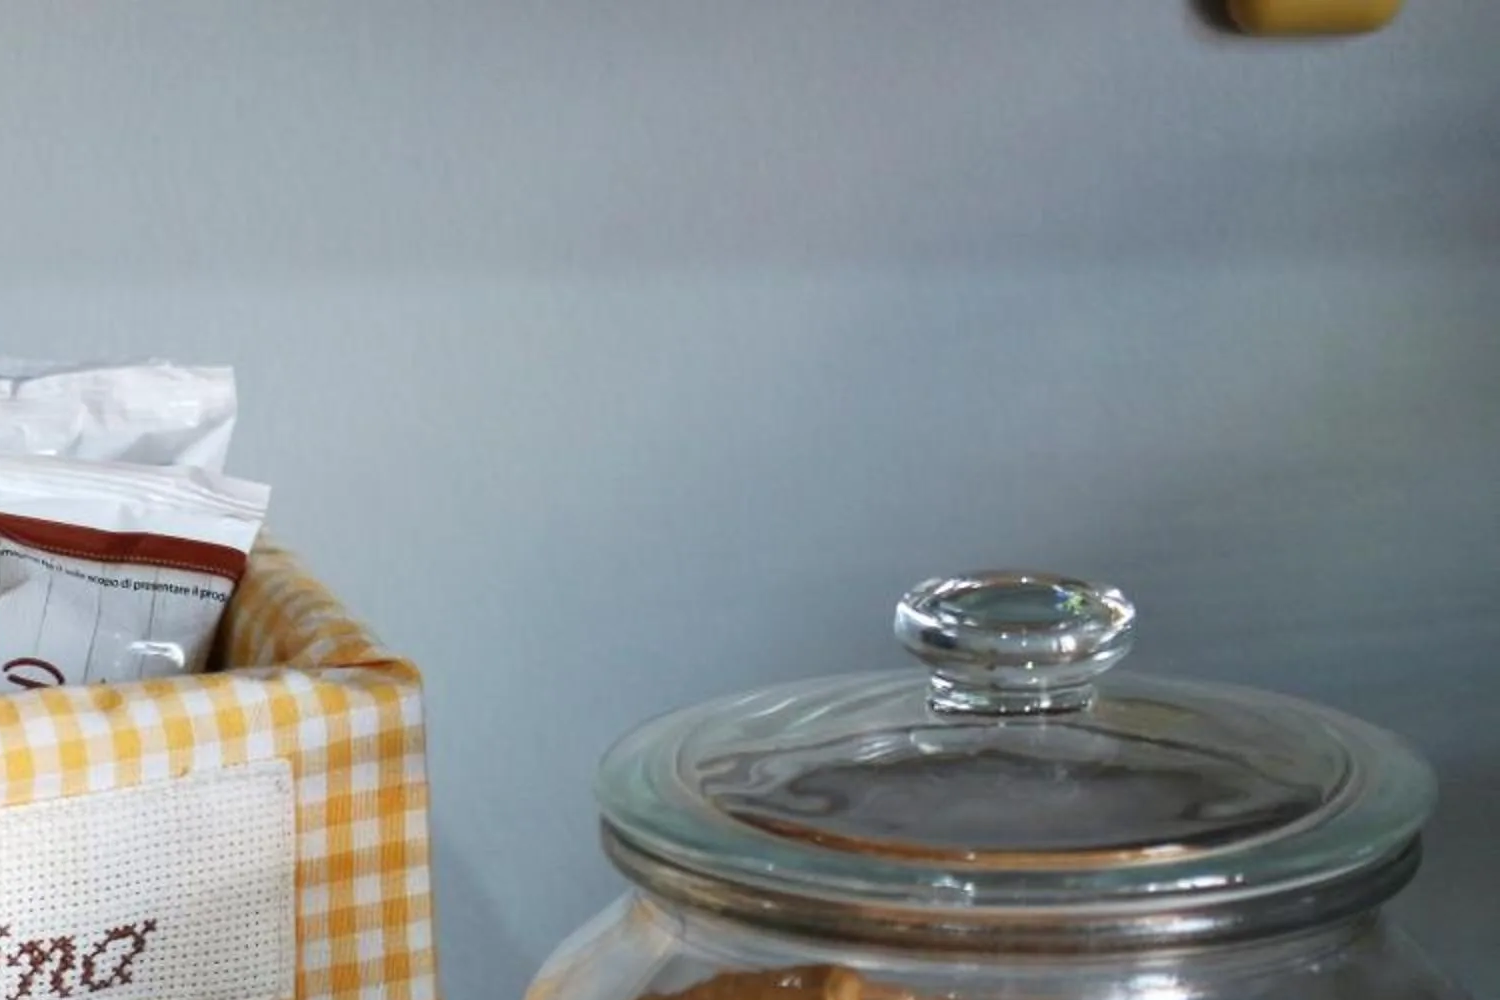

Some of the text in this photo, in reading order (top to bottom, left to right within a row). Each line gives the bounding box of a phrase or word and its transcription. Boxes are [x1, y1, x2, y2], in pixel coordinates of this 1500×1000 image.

[87, 575, 119, 588] scopo
[121, 579, 131, 589] di
[133, 580, 190, 597] presentare
